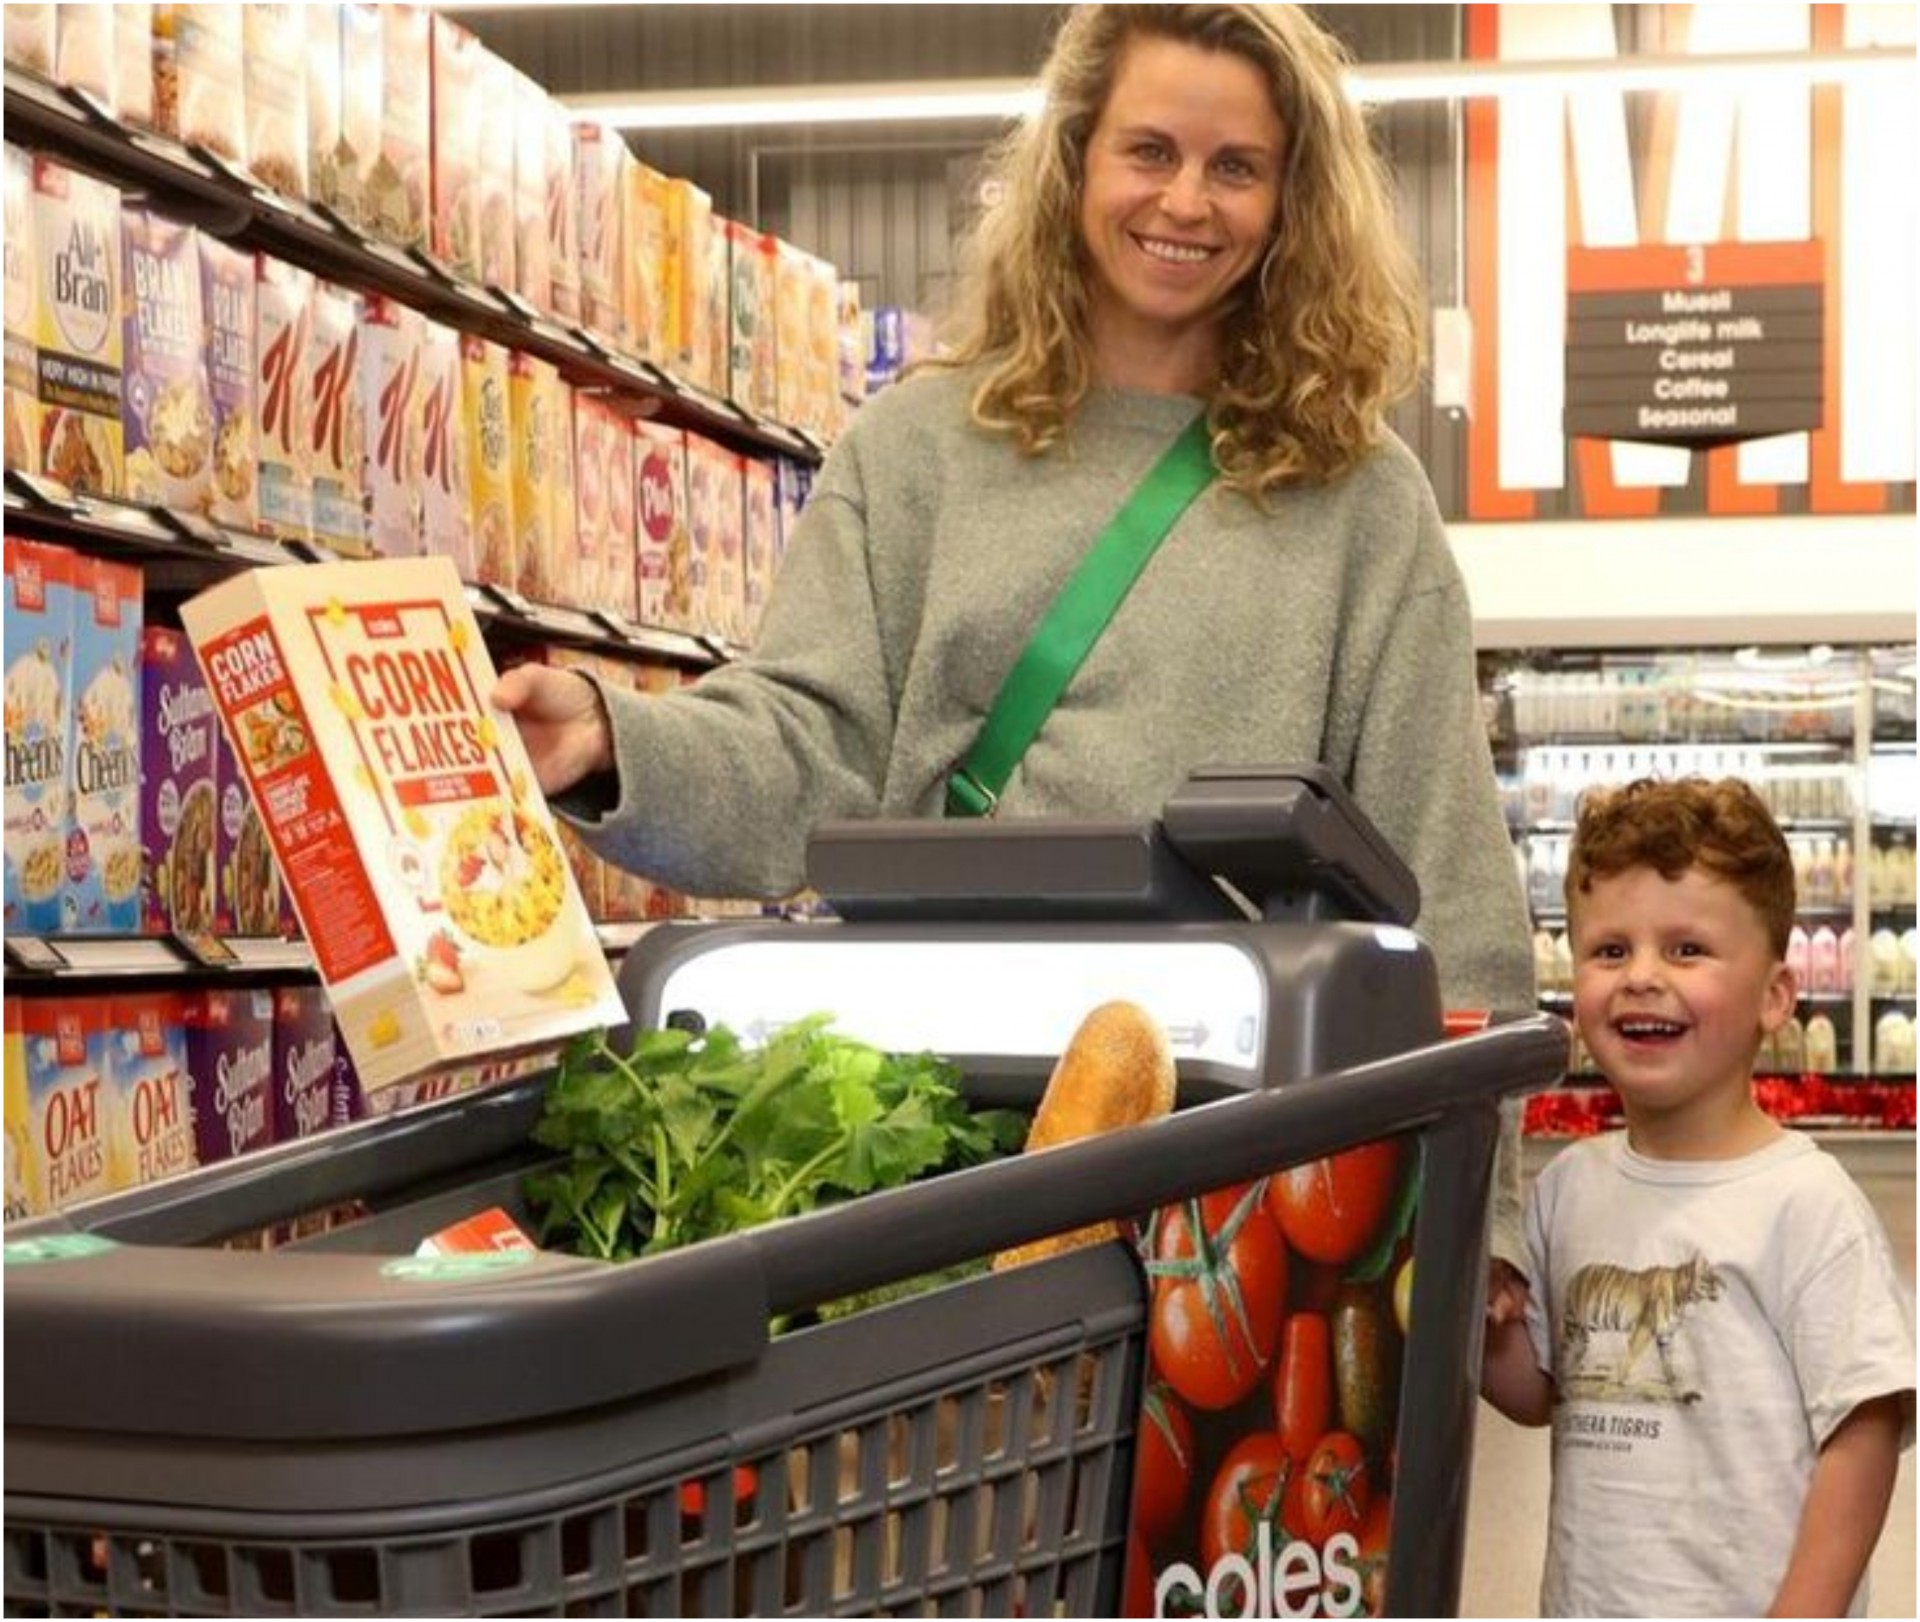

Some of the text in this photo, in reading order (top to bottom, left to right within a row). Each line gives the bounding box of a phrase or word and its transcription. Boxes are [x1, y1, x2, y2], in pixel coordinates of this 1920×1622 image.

[56, 252, 109, 316] Bran
[1686, 245, 1705, 284] 3
[1662, 289, 1732, 313] Muesli
[1625, 317, 1764, 346] Longlife milk
[1659, 348, 1735, 371] Cereal
[314, 324, 358, 470] K
[379, 344, 420, 485] K
[1638, 403, 1738, 428] Seasonal
[1654, 377, 1729, 400] Coffee
[210, 629, 276, 682] CORN
[220, 658, 284, 707] FLAKES
[346, 648, 466, 721] CORN
[371, 718, 486, 776] FLAKES
[44, 1079, 99, 1160] OAT
[133, 1069, 180, 1146] OAT
[50, 1146, 104, 1201] FLAKES
[1609, 1414, 1662, 1440] TIGRIS
[1154, 1520, 1362, 1618] coles
